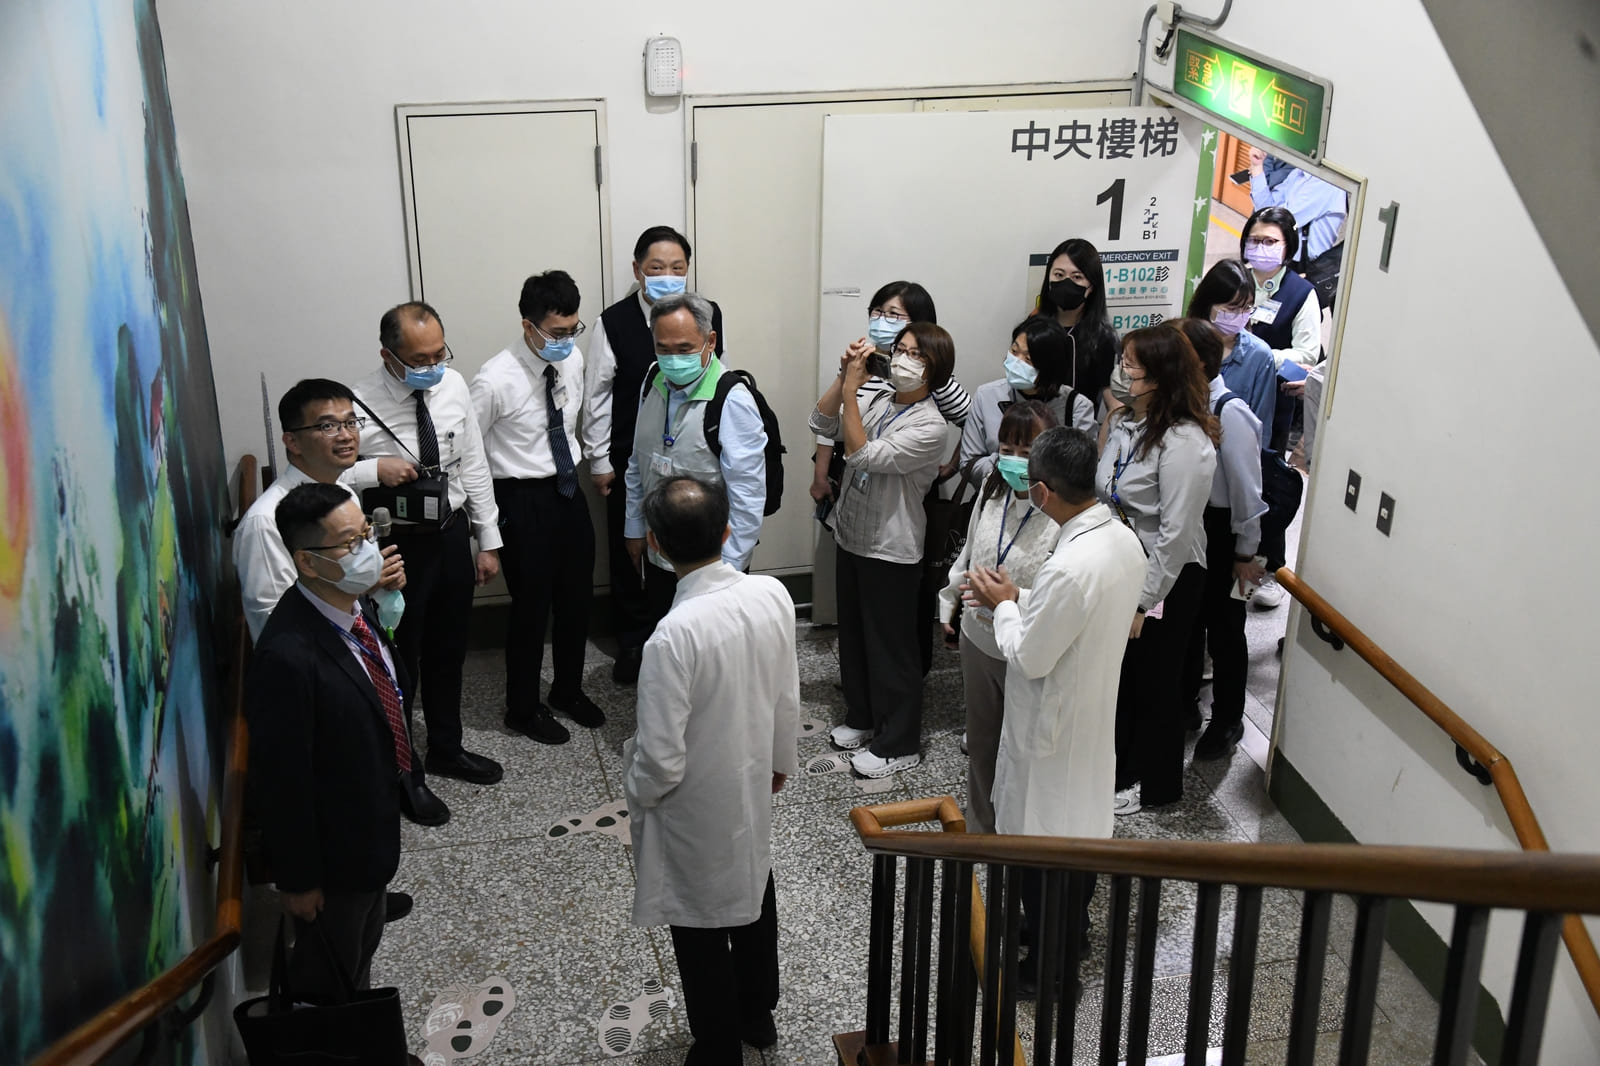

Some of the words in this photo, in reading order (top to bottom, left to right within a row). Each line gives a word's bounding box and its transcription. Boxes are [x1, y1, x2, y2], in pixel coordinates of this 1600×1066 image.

[1188, 54, 1213, 87] 緊急
[1271, 93, 1303, 127] 出口
[1011, 116, 1179, 161] 中央樓梯
[1096, 178, 1126, 241] 1
[1150, 197, 1157, 206] 2
[1142, 230, 1157, 240] B1
[1152, 251, 1171, 261] EXIT
[1378, 200, 1400, 273] 1
